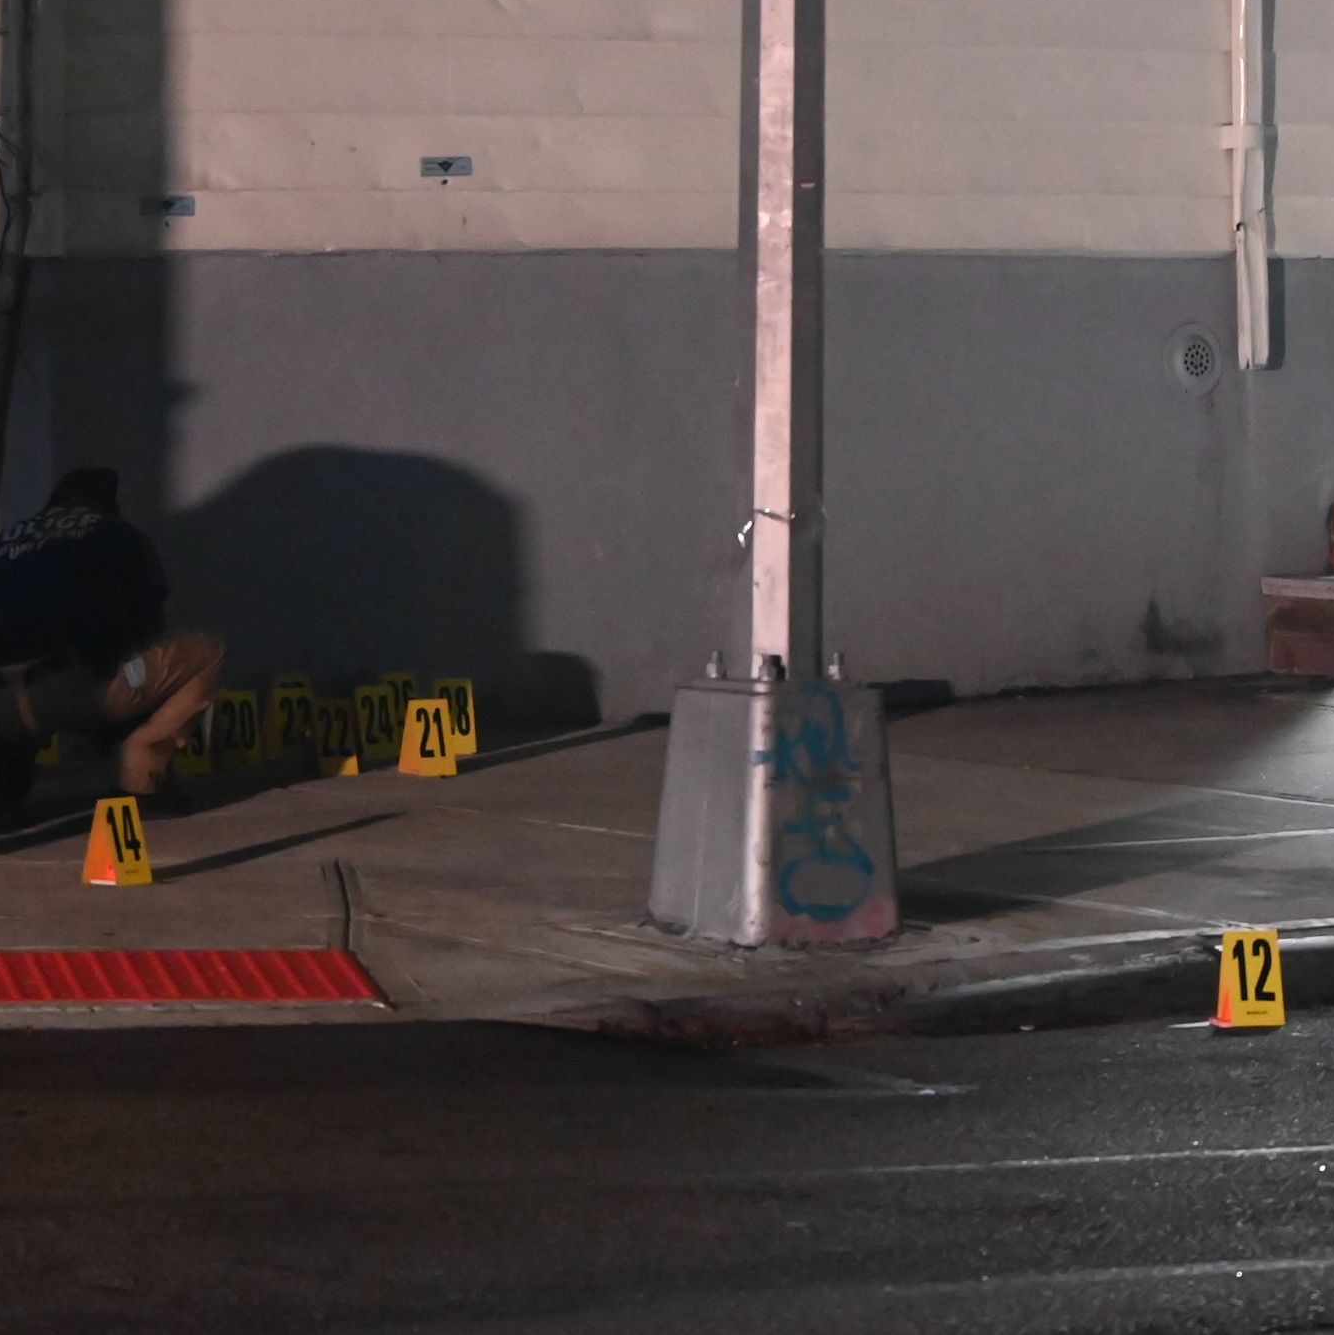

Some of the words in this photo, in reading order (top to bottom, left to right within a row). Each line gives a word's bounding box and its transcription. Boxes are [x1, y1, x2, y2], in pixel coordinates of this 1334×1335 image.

[416, 707, 446, 758] 21
[106, 805, 141, 863] 14
[1232, 938, 1276, 1001] 12
